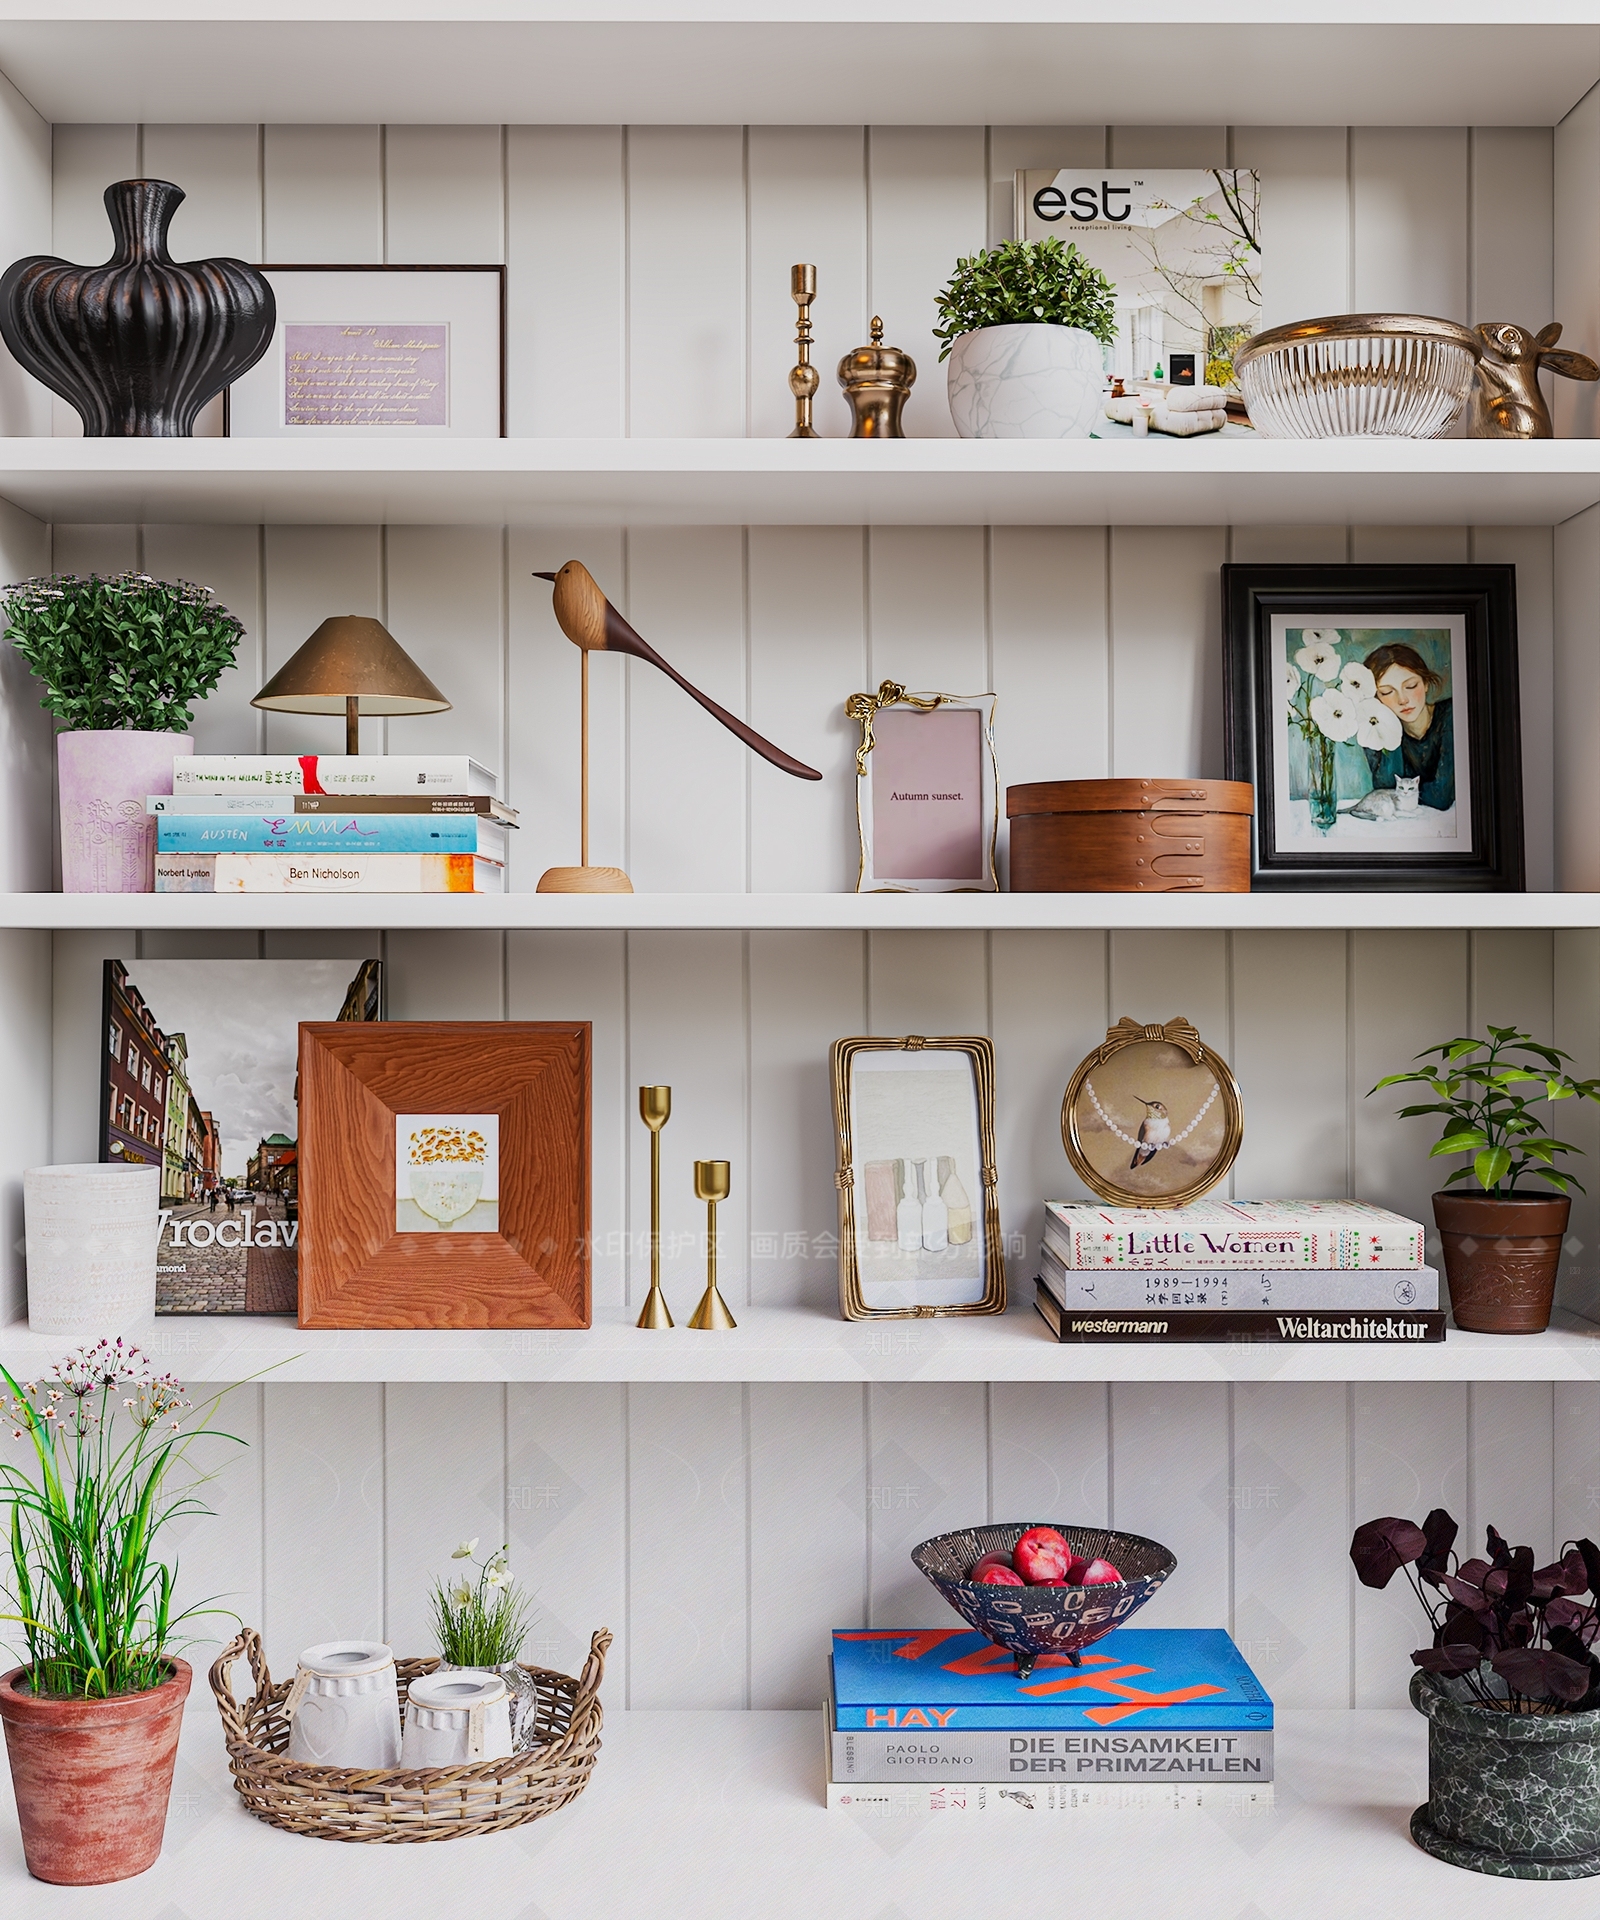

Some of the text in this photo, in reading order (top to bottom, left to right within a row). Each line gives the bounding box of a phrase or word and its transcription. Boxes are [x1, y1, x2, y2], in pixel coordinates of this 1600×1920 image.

[1033, 181, 1131, 222] est
[1112, 224, 1132, 232] living
[890, 791, 964, 801] Autumn sunset.
[200, 829, 249, 842] AUSTEN
[157, 868, 210, 878] Norbert Lynton
[289, 868, 360, 879] Ben Nicholson
[1127, 1231, 1295, 1255] Little Women
[1145, 1292, 1207, 1305] 文学回忆录
[1071, 1316, 1429, 1339] westermann Weltarchitektur
[866, 1708, 957, 1727] HAY
[886, 1745, 940, 1753] PAOLO
[1009, 1738, 1238, 1753] DIE EINSAMKEIT
[846, 1736, 854, 1774] BLESSING
[886, 1756, 974, 1765] GIORDANO
[1009, 1758, 1261, 1772] DER PRIMZAHLEN
[978, 1786, 986, 1810] NEXUS
